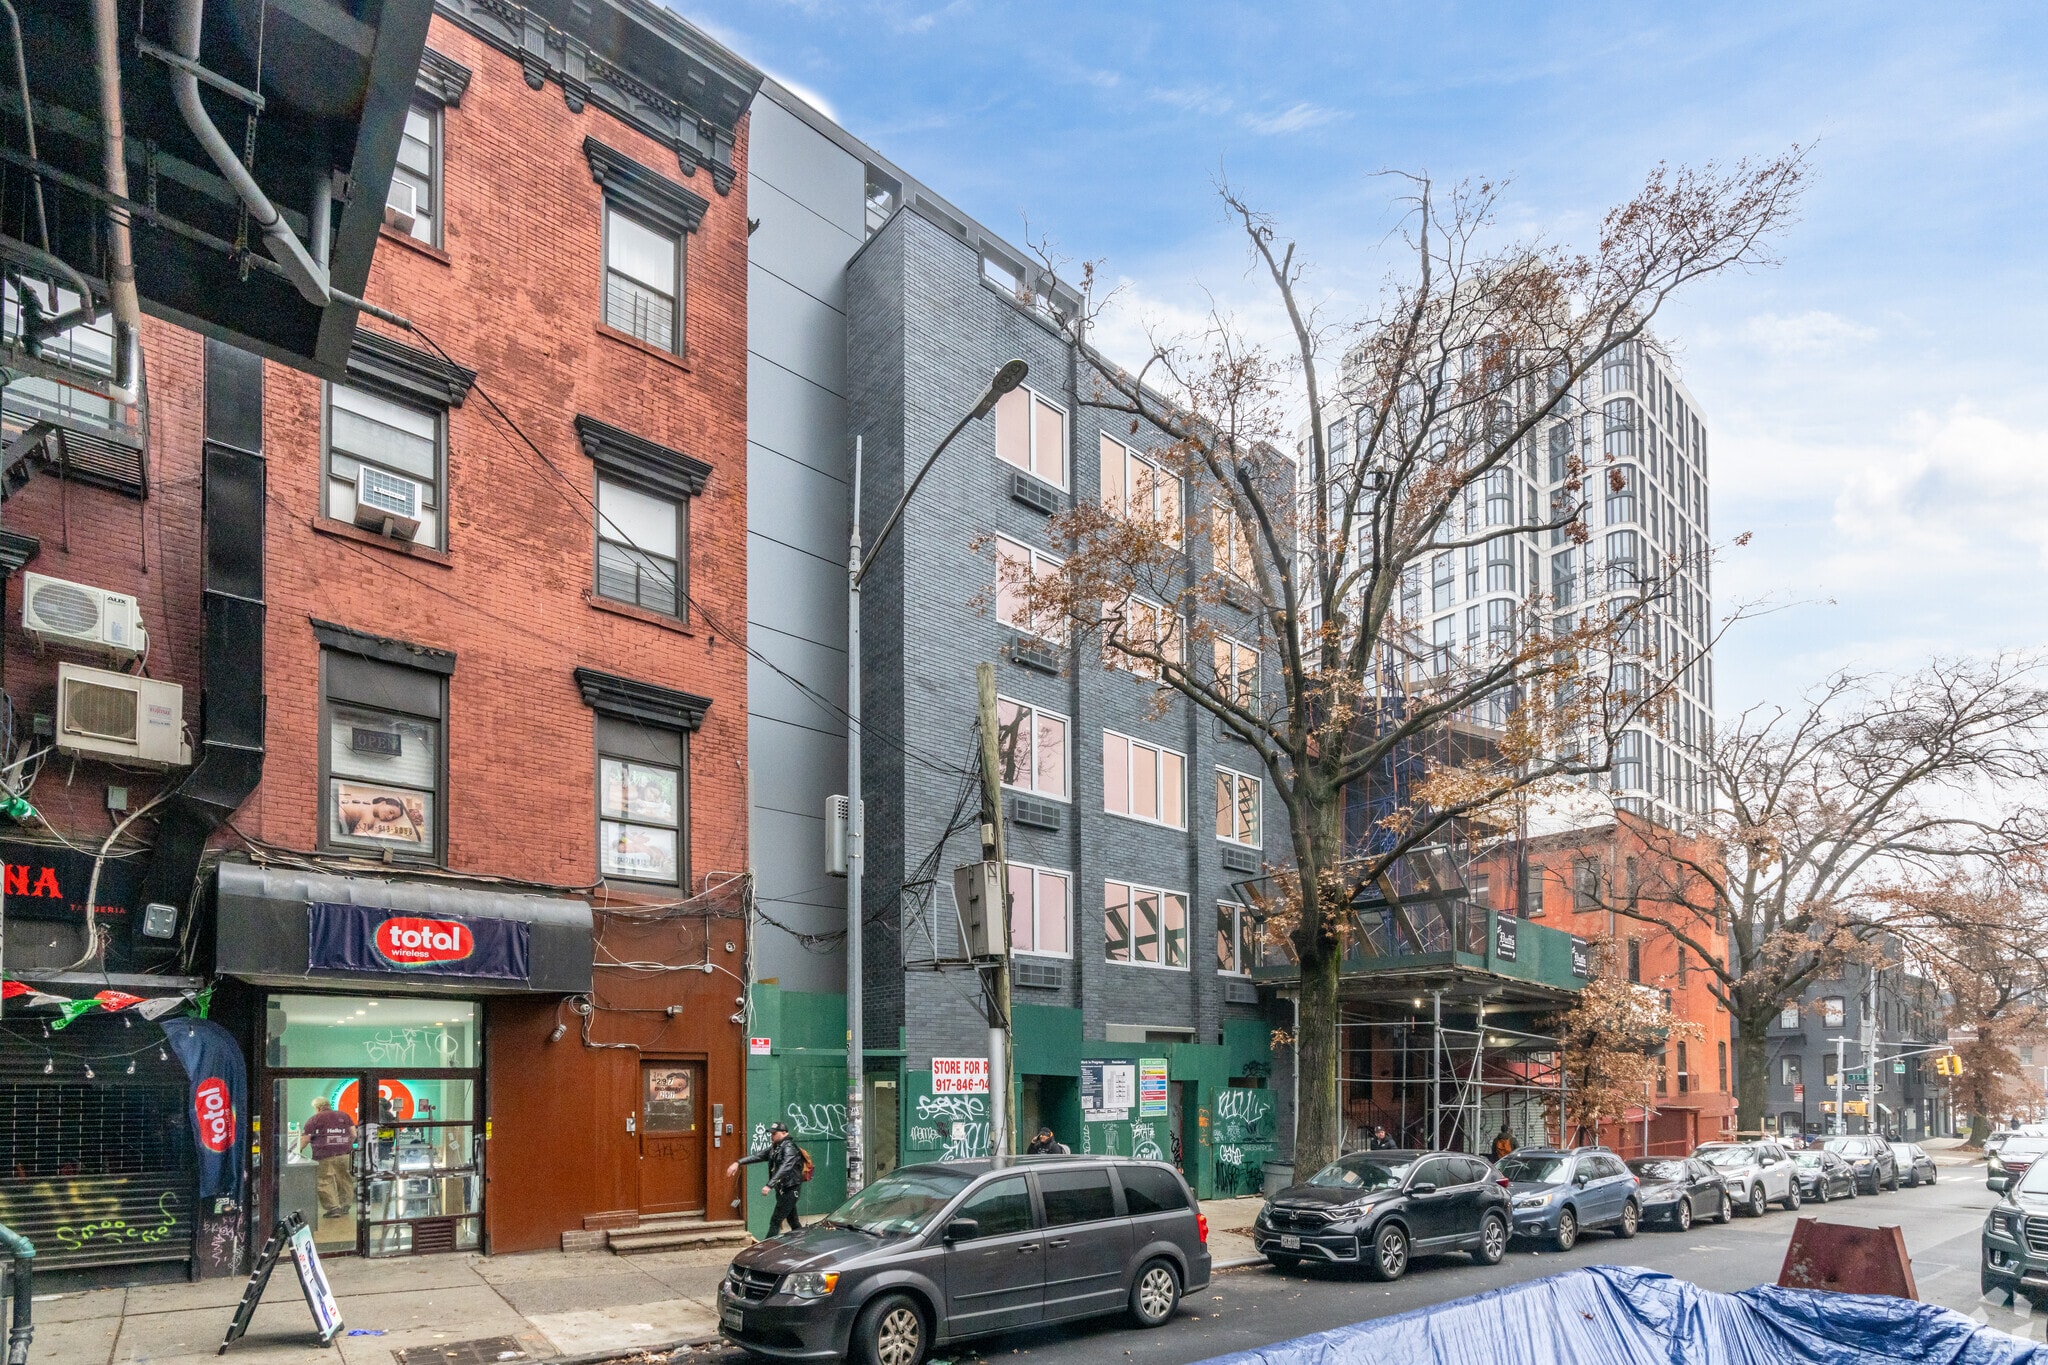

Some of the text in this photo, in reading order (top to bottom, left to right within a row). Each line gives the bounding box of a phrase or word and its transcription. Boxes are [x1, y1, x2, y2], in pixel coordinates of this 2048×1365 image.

[107, 596, 127, 604] AUX
[357, 734, 397, 753] OPEN
[389, 925, 460, 951] total
[391, 948, 430, 958] wireless
[934, 1060, 961, 1074] STORE
[964, 1060, 980, 1074] FOR
[198, 1087, 228, 1144] total
